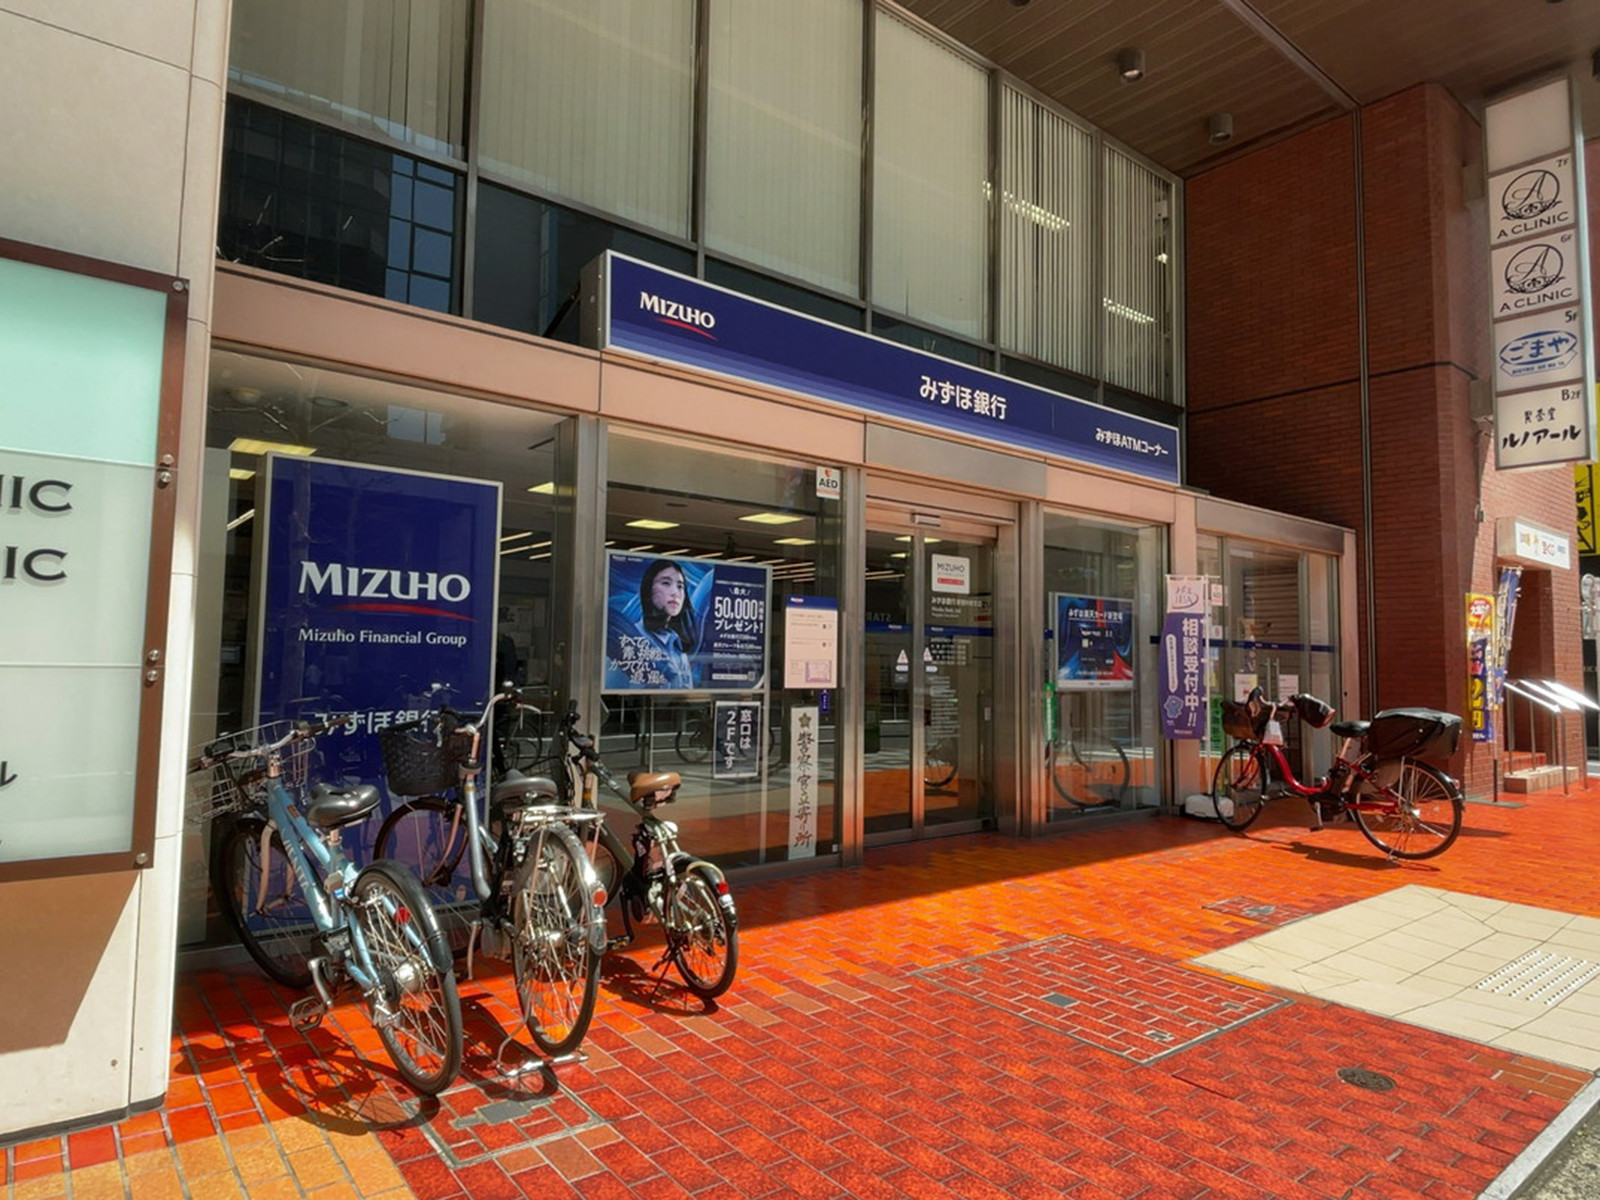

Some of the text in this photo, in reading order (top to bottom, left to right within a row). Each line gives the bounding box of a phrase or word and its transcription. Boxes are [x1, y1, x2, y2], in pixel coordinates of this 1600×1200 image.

[1497, 211, 1569, 240] A CLINIC
[640, 291, 716, 329] MIZUHO
[1500, 288, 1573, 313] A CLINIC
[1509, 336, 1569, 361] ごまや
[920, 376, 1007, 420] みずほ銀行
[1561, 389, 1582, 402] B2F
[1096, 428, 1169, 457] みずほATMコーナー
[1502, 424, 1582, 449] ルノアール
[819, 477, 838, 489] AED
[937, 563, 965, 573] MIZUHO
[298, 561, 471, 602] MIZUHO
[715, 597, 758, 620] 50,000
[298, 628, 467, 647] Mizuho Financial Group
[714, 619, 764, 634] プレゼント!
[1182, 618, 1199, 727] 相談受付中!!
[723, 711, 736, 769] 2Fです
[740, 709, 752, 749] 窓口は
